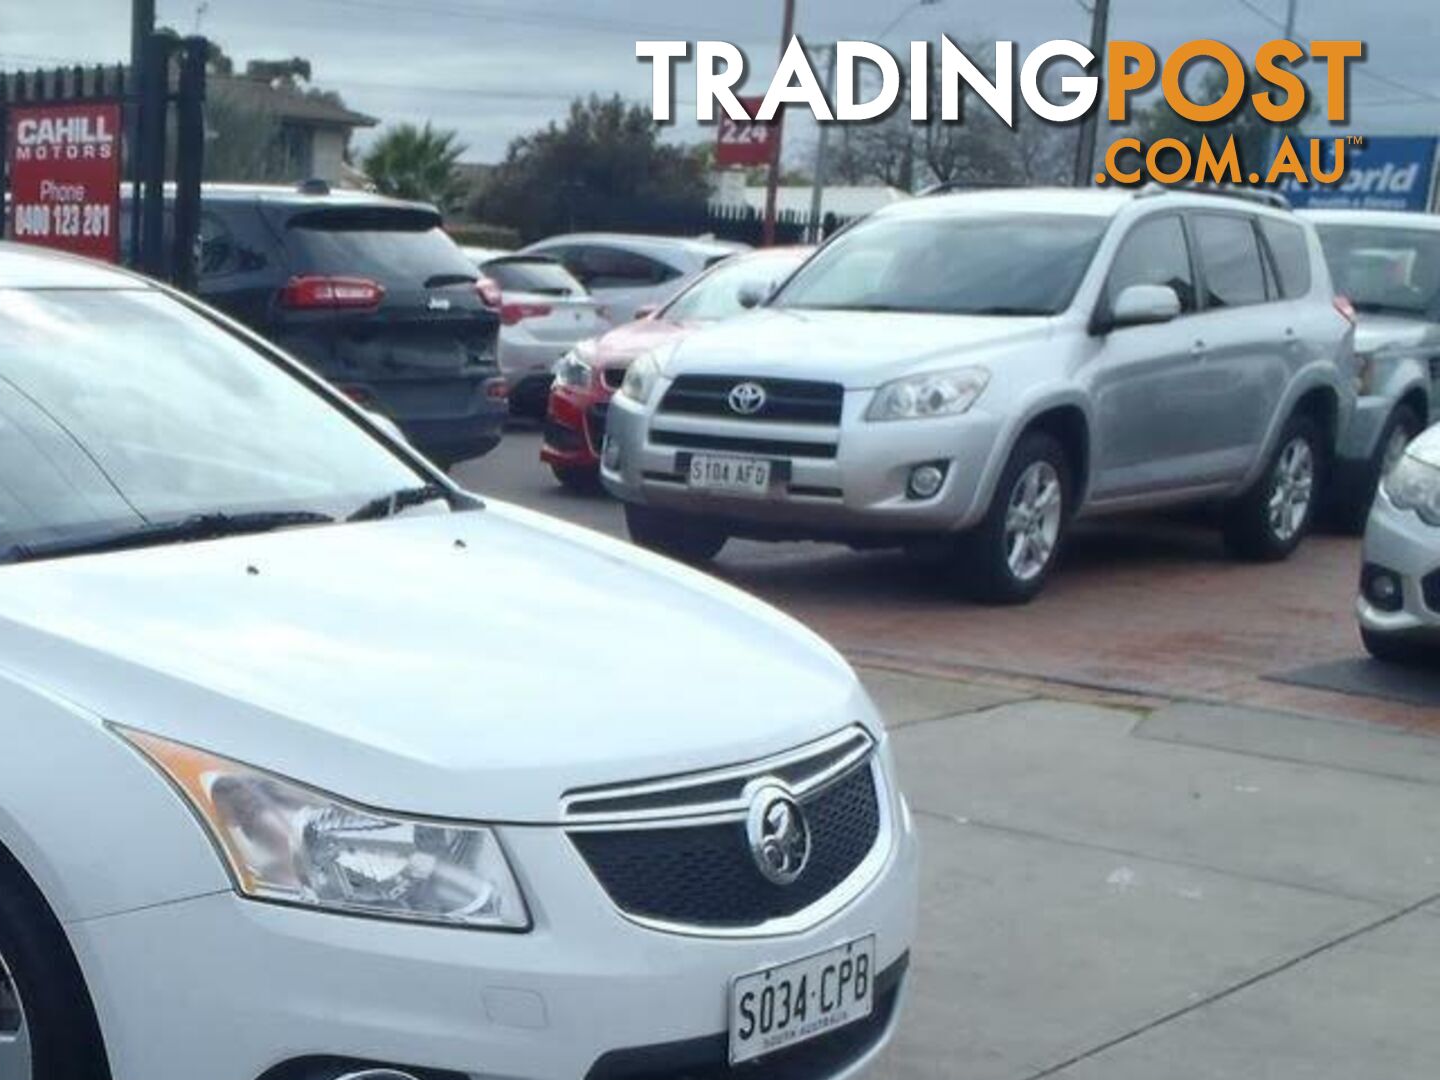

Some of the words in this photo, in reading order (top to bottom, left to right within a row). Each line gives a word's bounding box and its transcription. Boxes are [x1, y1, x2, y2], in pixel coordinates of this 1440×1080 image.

[17, 116, 113, 145] CAHILL
[721, 119, 768, 144] 224
[16, 144, 112, 160] MOTORS
[40, 180, 85, 201] Phone
[54, 204, 80, 236] 123
